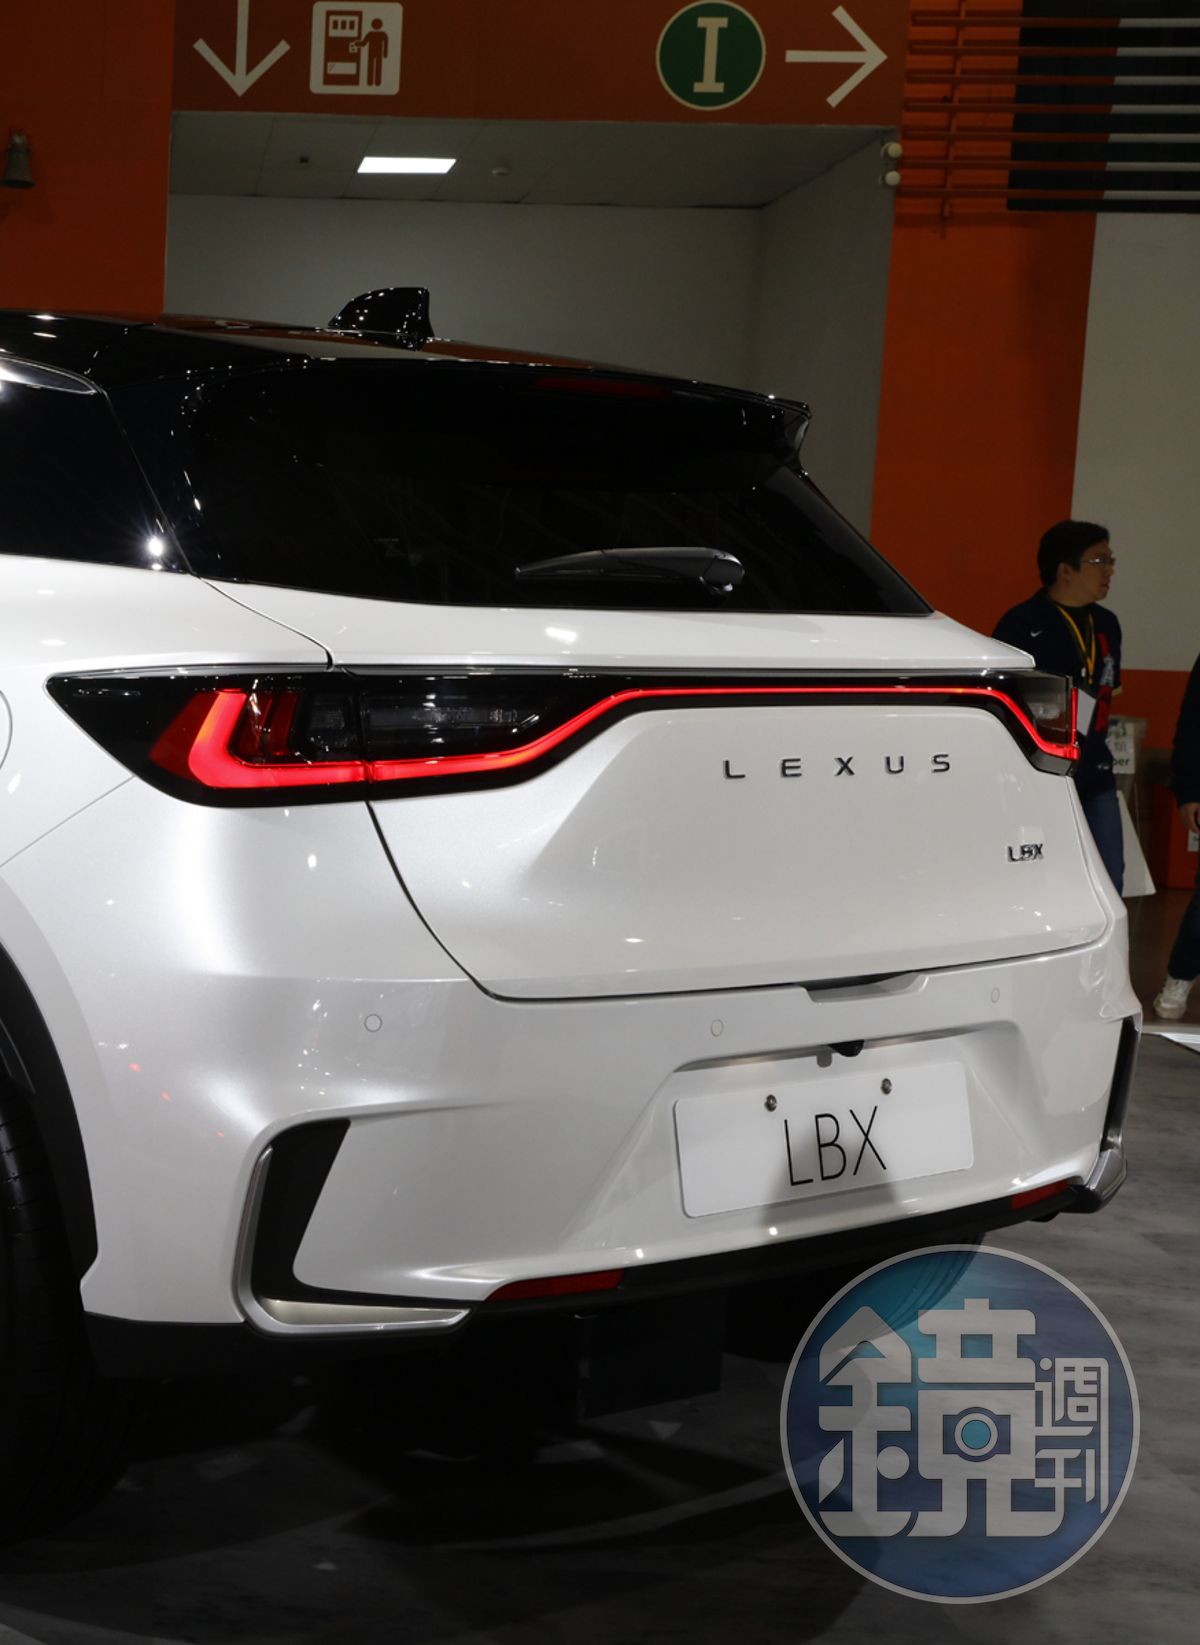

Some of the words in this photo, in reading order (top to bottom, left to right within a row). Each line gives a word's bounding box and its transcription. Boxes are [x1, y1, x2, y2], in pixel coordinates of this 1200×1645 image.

[723, 753, 951, 780] LEXUS
[1006, 842, 1044, 863] LBX
[783, 1105, 887, 1187] LBX
